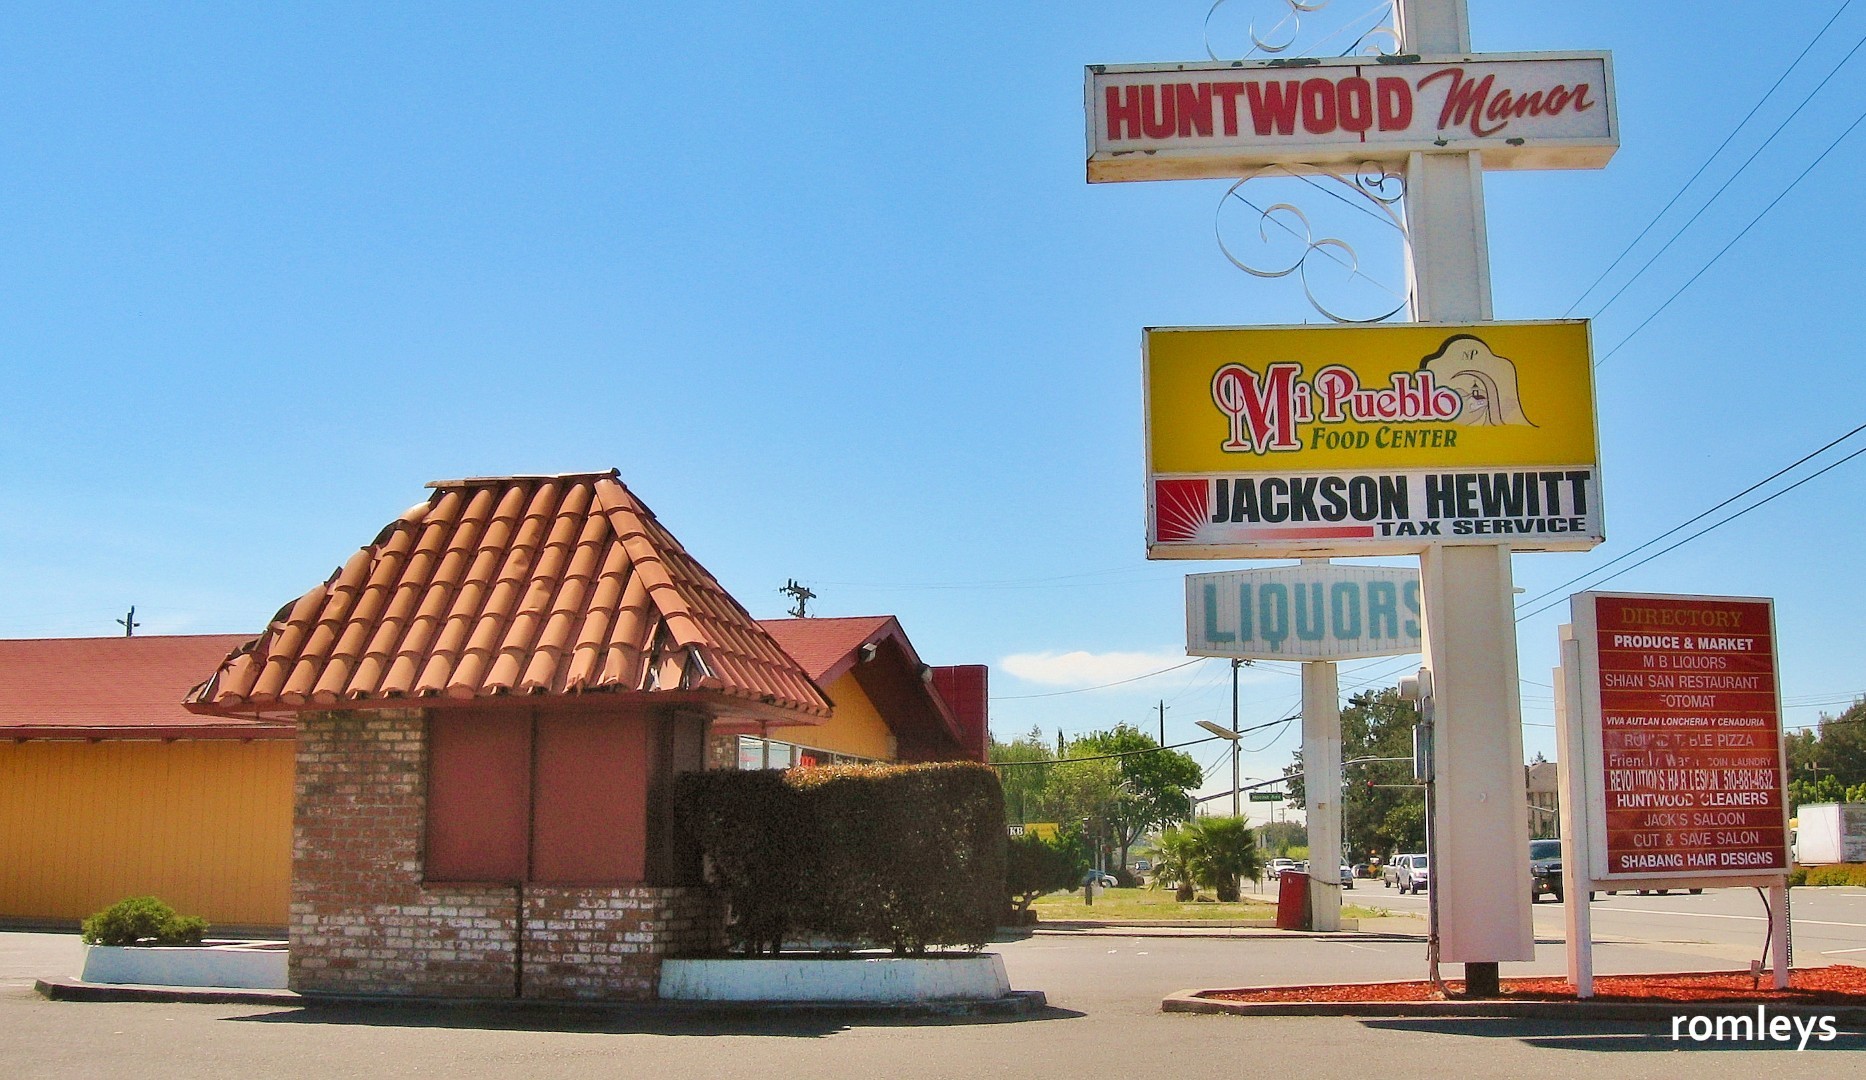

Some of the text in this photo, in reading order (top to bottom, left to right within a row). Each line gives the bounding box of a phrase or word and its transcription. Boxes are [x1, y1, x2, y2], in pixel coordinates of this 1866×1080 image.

[1106, 68, 1595, 140] HUNTWOOD Manor
[1212, 363, 1462, 454] Mi Pueblo
[1310, 425, 1457, 450] FOOD CENTER
[1212, 471, 1591, 523] JACKSON HEWITT
[1376, 517, 1586, 537] TAX SERVICE
[1203, 580, 1421, 651] LIQUORS
[1621, 607, 1743, 628] DIRECTORY
[1614, 634, 1754, 650] PRODUCE & MARKET
[1643, 655, 1727, 669] M B LIQUORS
[1604, 674, 1759, 689] SHIAN SAN RESTAURANT
[1606, 717, 1765, 727] VIVA AUTLAN LONCHERIA Y CENADURIA
[1717, 733, 1754, 747] PIZZA
[1731, 757, 1771, 767] LAUNDRY
[1617, 791, 1769, 807] HUNTWOOD CLEANERS
[1644, 812, 1746, 827] JACK'S SALOON
[1633, 831, 1760, 847] CUT & SAVE SALON
[1621, 852, 1774, 869] SHABANG HAIR DESIGNS
